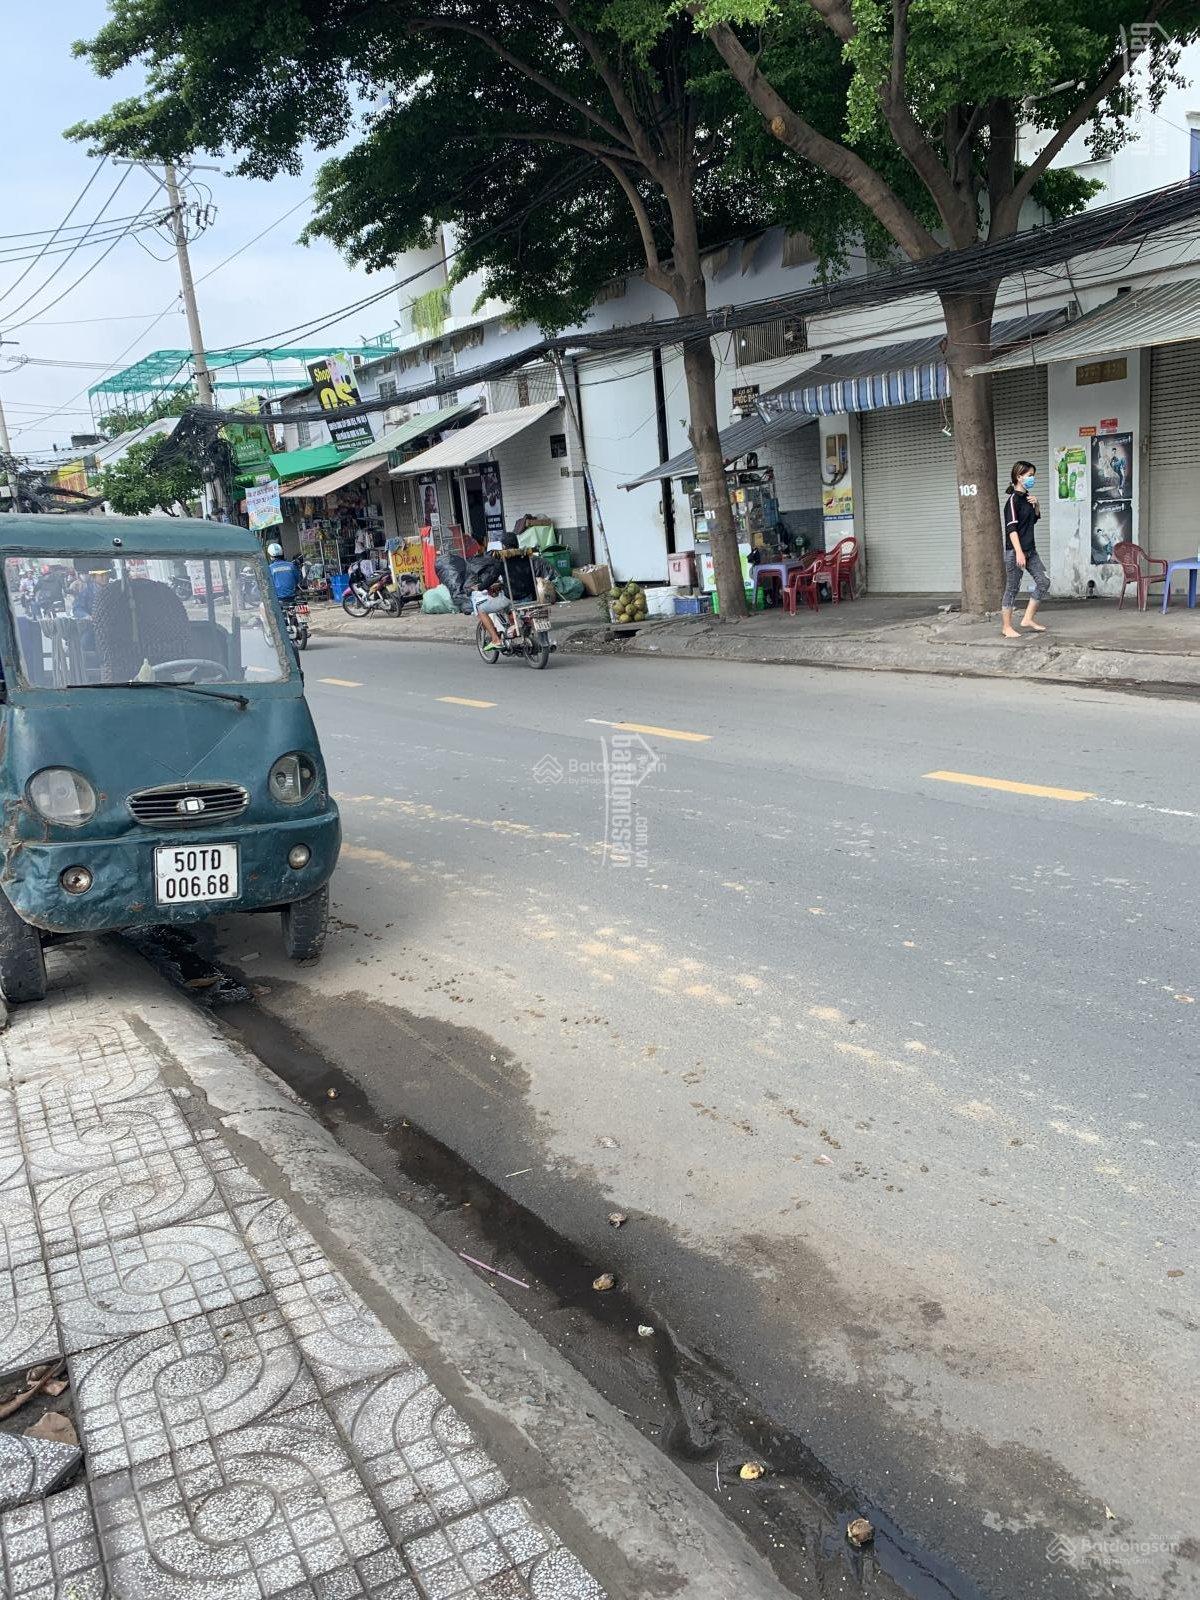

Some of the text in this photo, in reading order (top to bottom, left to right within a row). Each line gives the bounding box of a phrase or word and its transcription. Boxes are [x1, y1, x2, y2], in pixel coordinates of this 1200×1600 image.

[313, 367, 331, 382] Shop
[959, 484, 978, 496] 103
[174, 849, 221, 872] 50TD
[166, 874, 229, 898] 006.68
